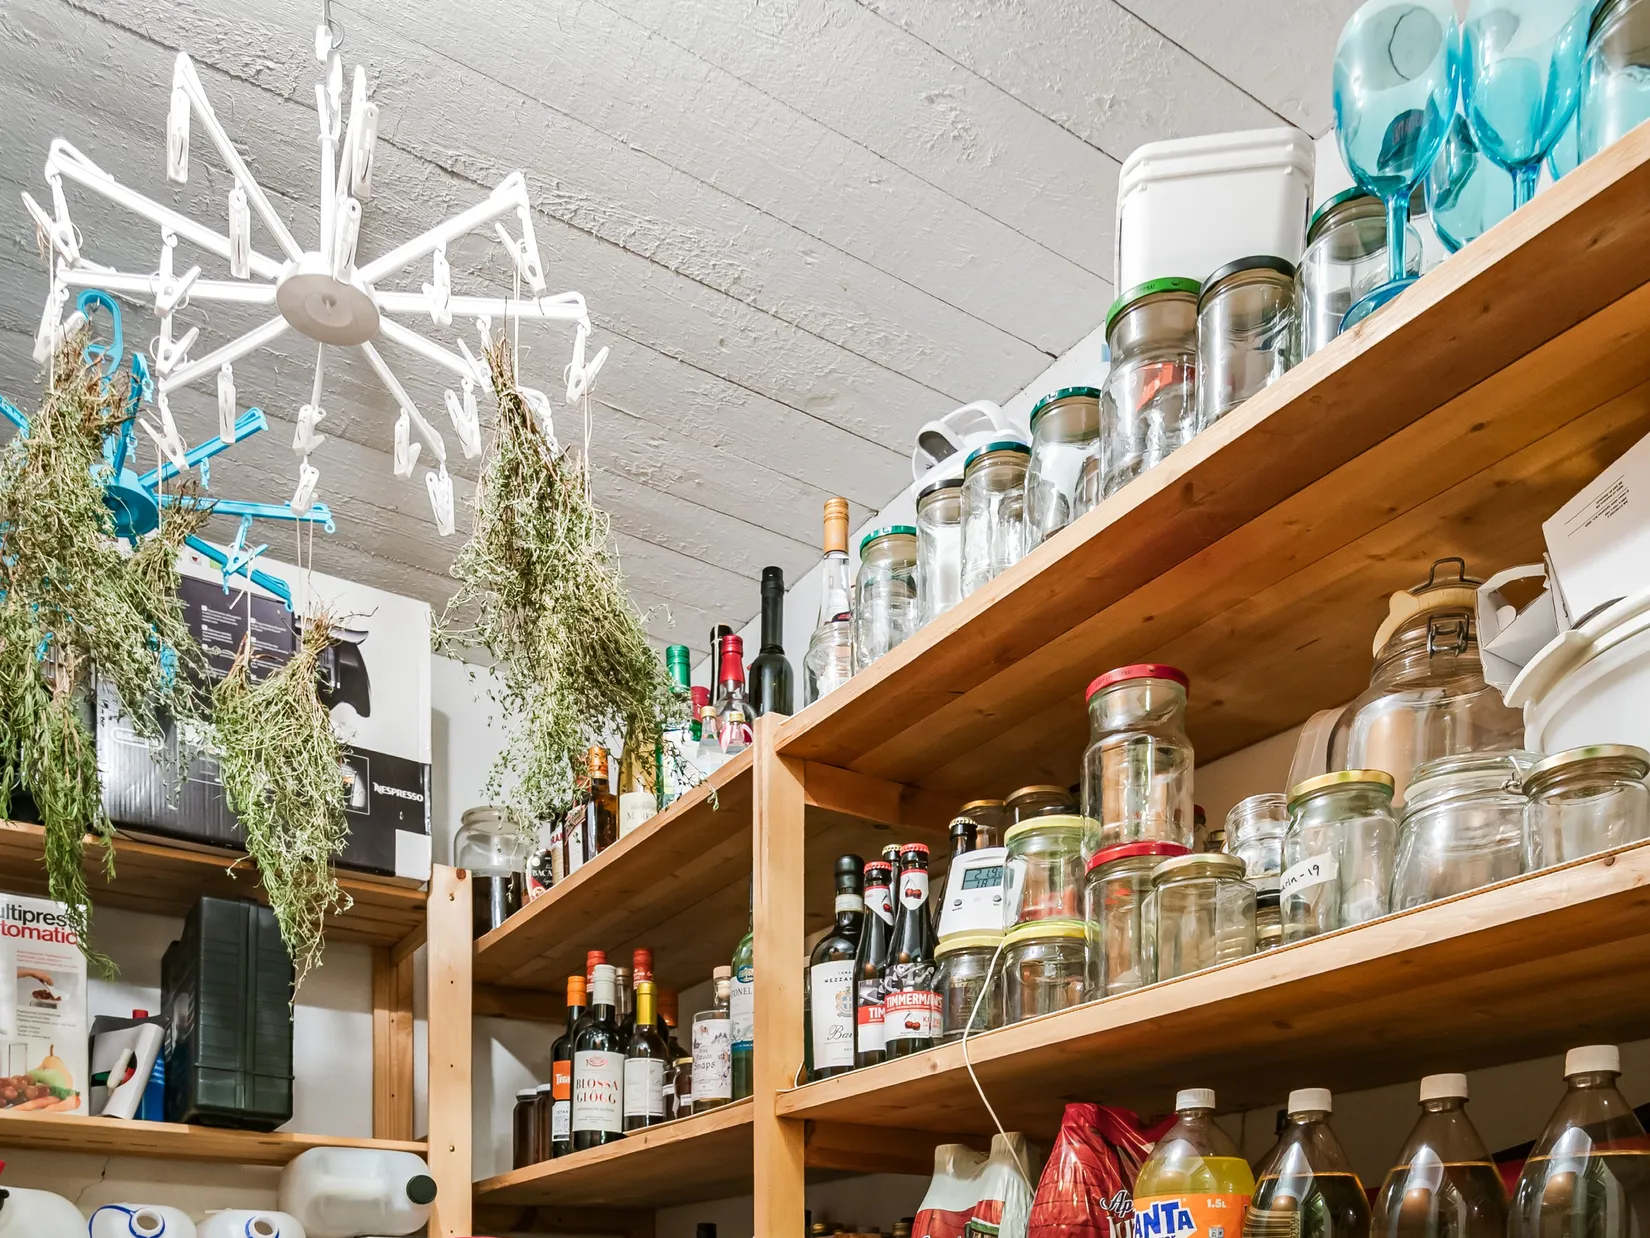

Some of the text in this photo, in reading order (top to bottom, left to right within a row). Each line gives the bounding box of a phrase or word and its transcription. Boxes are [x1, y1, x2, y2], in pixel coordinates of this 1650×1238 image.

[372, 781, 424, 802] NESPRESSO
[1307, 864, 1320, 877] 19
[576, 1078, 619, 1092] BLOSSA
